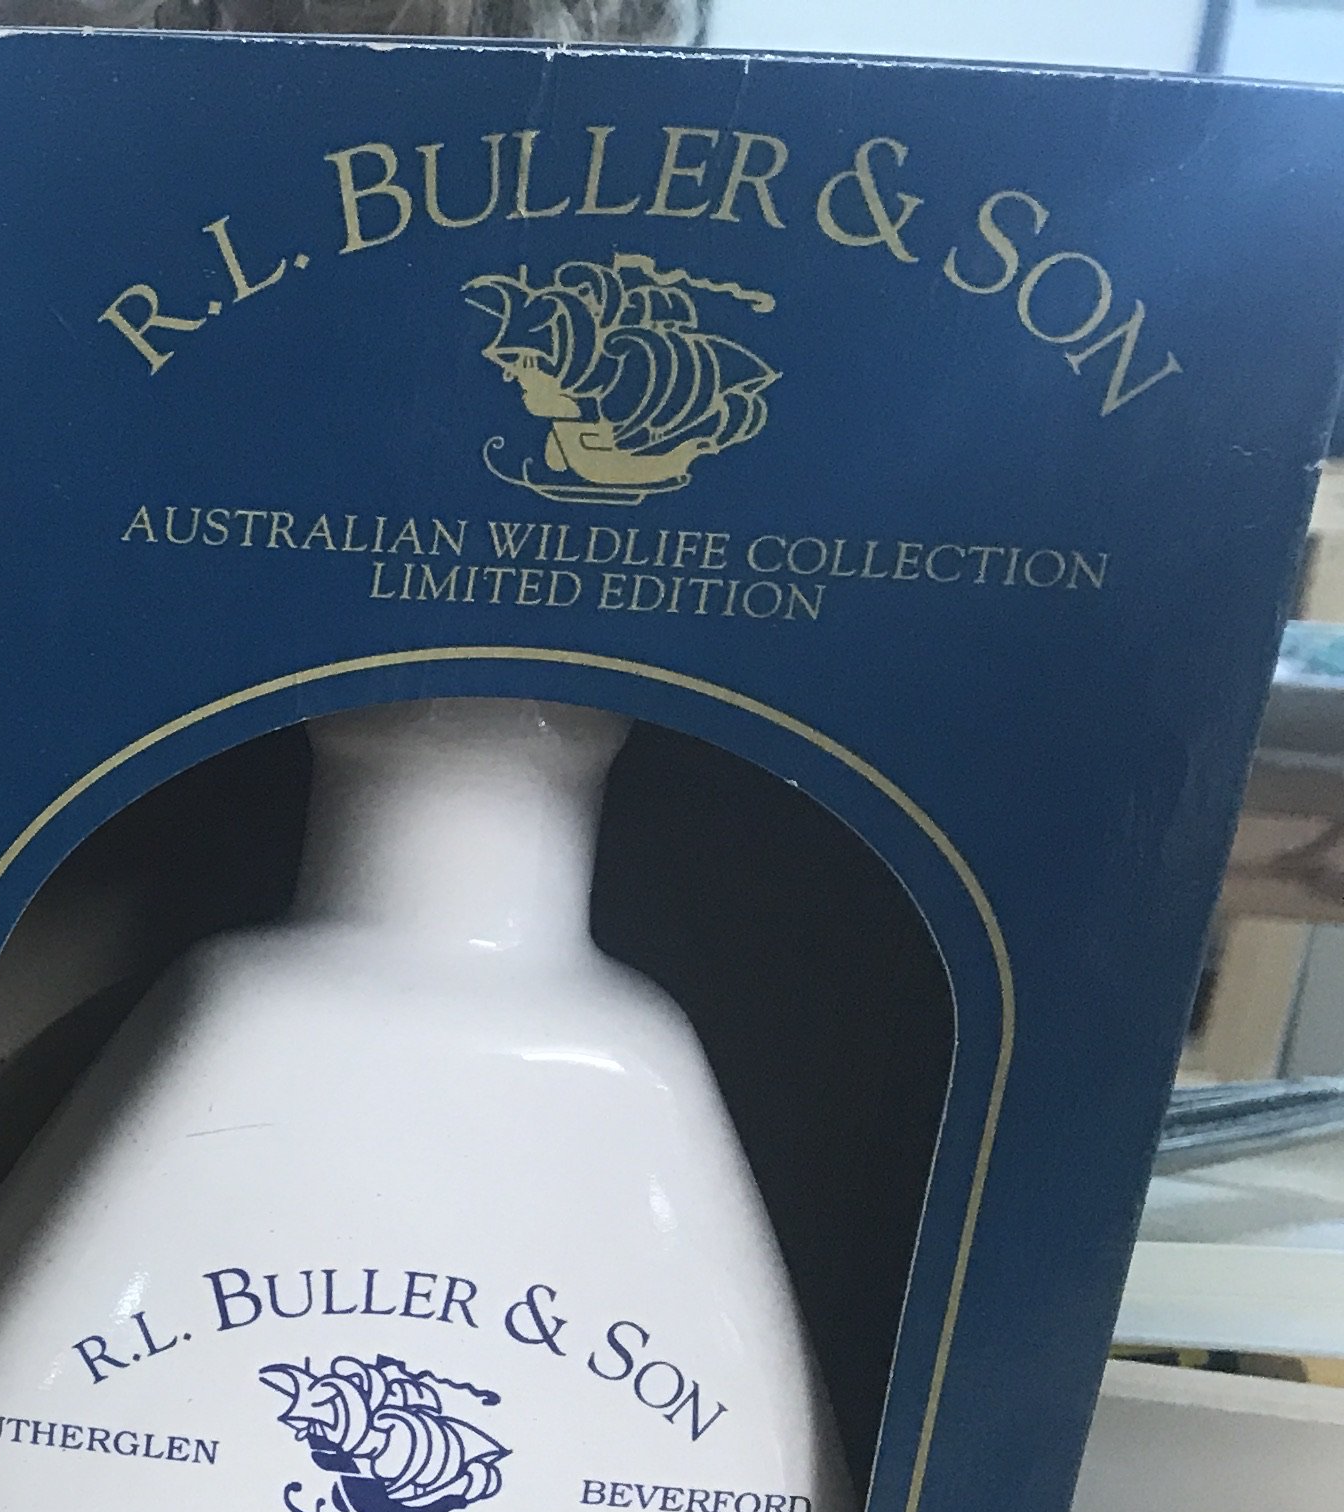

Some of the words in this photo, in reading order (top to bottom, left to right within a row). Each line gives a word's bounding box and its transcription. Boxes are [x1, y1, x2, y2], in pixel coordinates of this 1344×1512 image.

[97, 215, 310, 375] R.L.
[324, 126, 789, 254] BULLER
[817, 137, 924, 262] &
[943, 191, 1184, 416] SON
[121, 505, 467, 556] AUSTRALIAN
[489, 519, 730, 571] WILDLIFE
[747, 535, 1109, 590] COLLECTION
[370, 561, 582, 608] LIMITED
[598, 572, 826, 620] EDITION
[72, 1308, 192, 1385] R.L.
[204, 1267, 479, 1331] BULLER
[504, 1283, 567, 1356] &
[587, 1320, 728, 1443] SON
